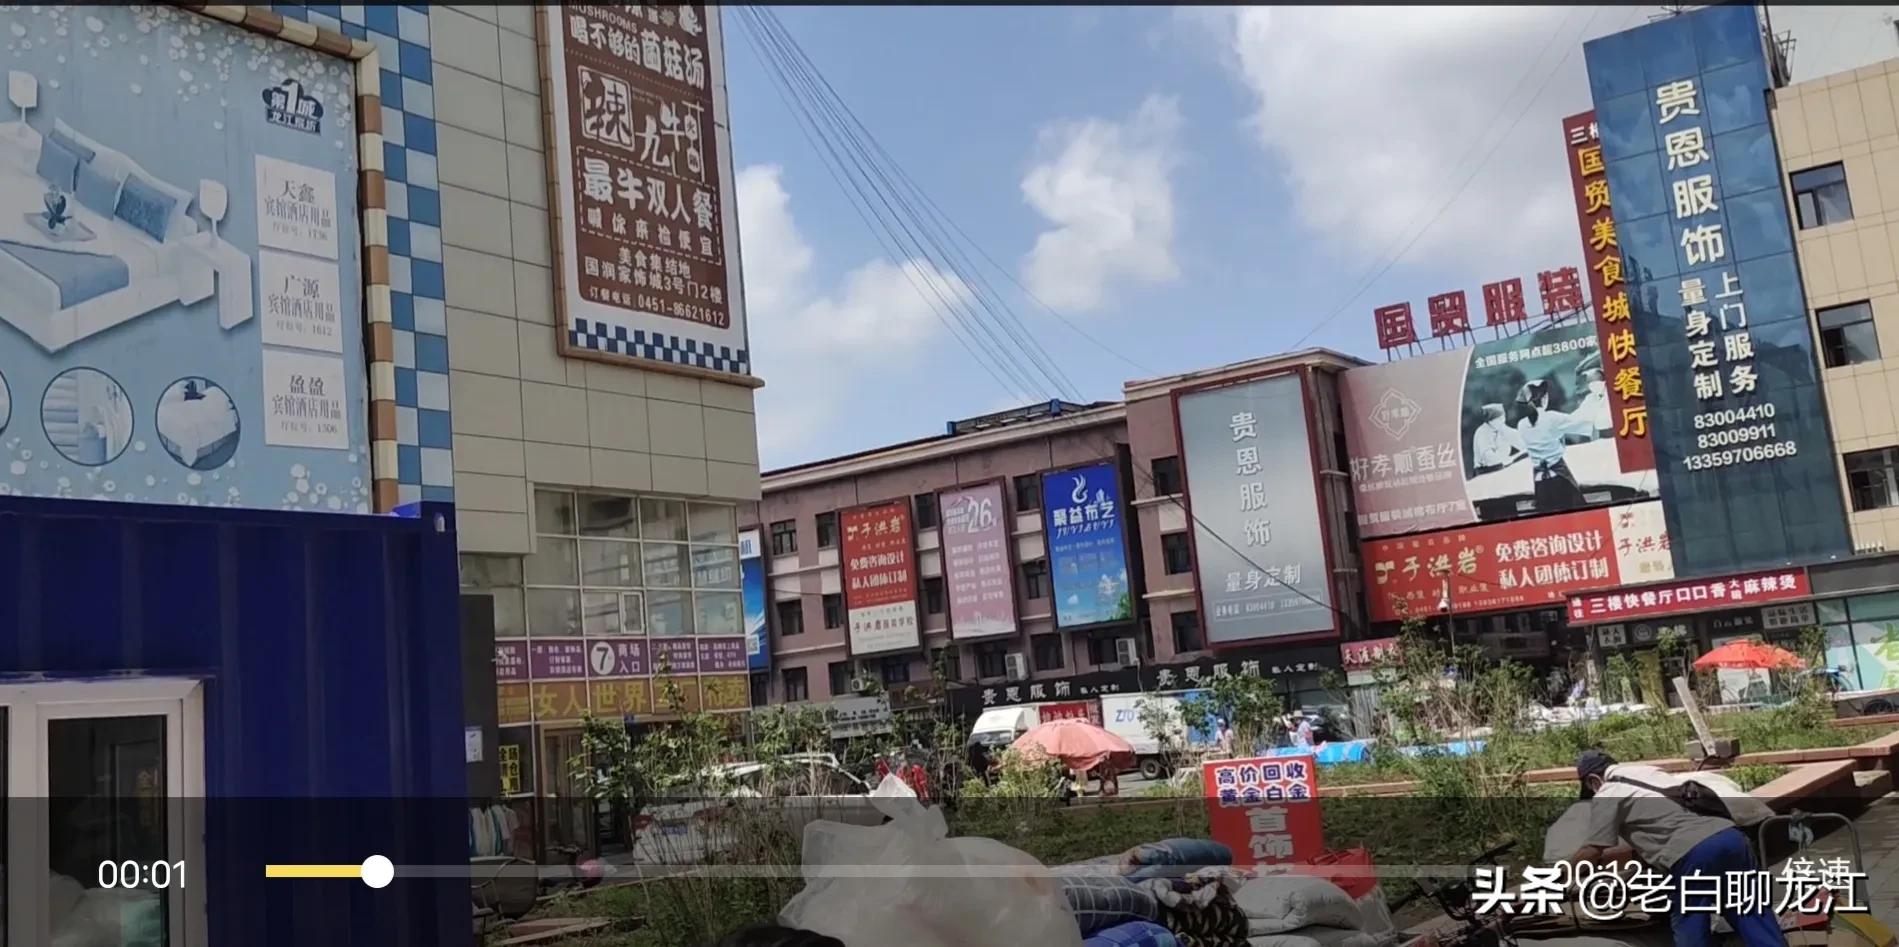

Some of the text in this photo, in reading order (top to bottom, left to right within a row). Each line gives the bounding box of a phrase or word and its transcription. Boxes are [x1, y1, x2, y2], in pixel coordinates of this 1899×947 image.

[1655, 79, 1725, 266] 贵恩服饰
[280, 180, 315, 203] 天鑫
[583, 157, 713, 232] 最牛双人餐
[264, 196, 332, 228] 宾馆酒店用品
[618, 247, 692, 280] 美食集结地
[283, 275, 320, 299] 广源
[584, 256, 723, 305] 国润家饰城3号门2楼
[1578, 145, 1648, 438] 国贸美食城快餐厅
[268, 293, 336, 323] 宾馆酒店用品
[1678, 278, 1724, 400] 量身定制
[1714, 271, 1758, 394] 上门服务
[272, 394, 342, 420] 宾馆酒店用品
[1693, 402, 1776, 429] 83004410
[1697, 423, 1776, 449] 83009911
[1683, 440, 1798, 471] 13359706668
[1229, 411, 1272, 547] 贵恩服饰
[1494, 529, 1604, 562] 免费咨询设计
[849, 550, 905, 571] 免费咨询设计
[1497, 556, 1610, 591] 私人团体订制
[851, 570, 908, 590] 私人团体订制
[1224, 563, 1302, 593] 量身定制
[1744, 574, 1797, 595] 麻辣烫
[595, 646, 609, 671] 7
[618, 643, 642, 658] 商场
[619, 660, 643, 674] 入口
[981, 681, 1072, 706] 贵恩服饰
[1215, 762, 1308, 785] 高价回收
[1219, 783, 1311, 807] 黄金白金
